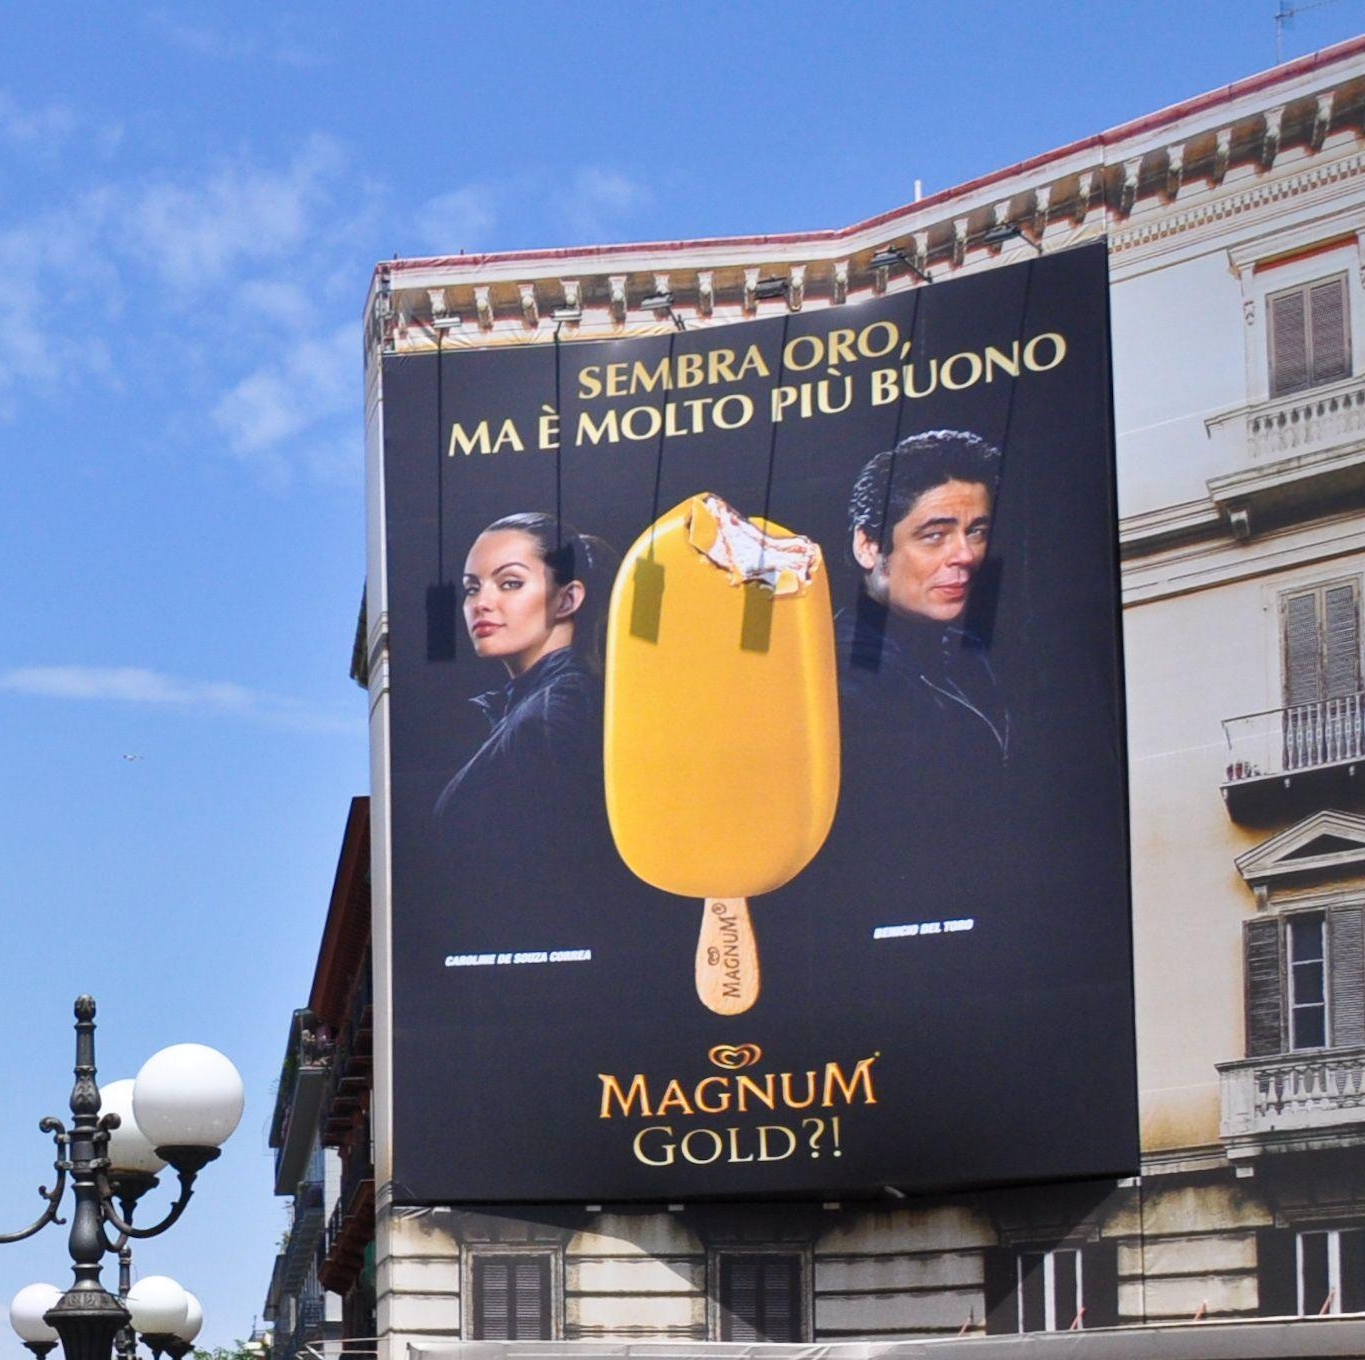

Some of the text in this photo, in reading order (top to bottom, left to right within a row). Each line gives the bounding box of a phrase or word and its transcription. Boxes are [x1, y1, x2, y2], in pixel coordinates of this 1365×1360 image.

[578, 321, 911, 399] SEMBRA ORO,
[448, 332, 1067, 457] MA È MOLTO PIÙ BUONO
[497, 953, 512, 964] DE
[598, 1057, 878, 1119] MAGNUM
[633, 1116, 842, 1166] GOLD?!
